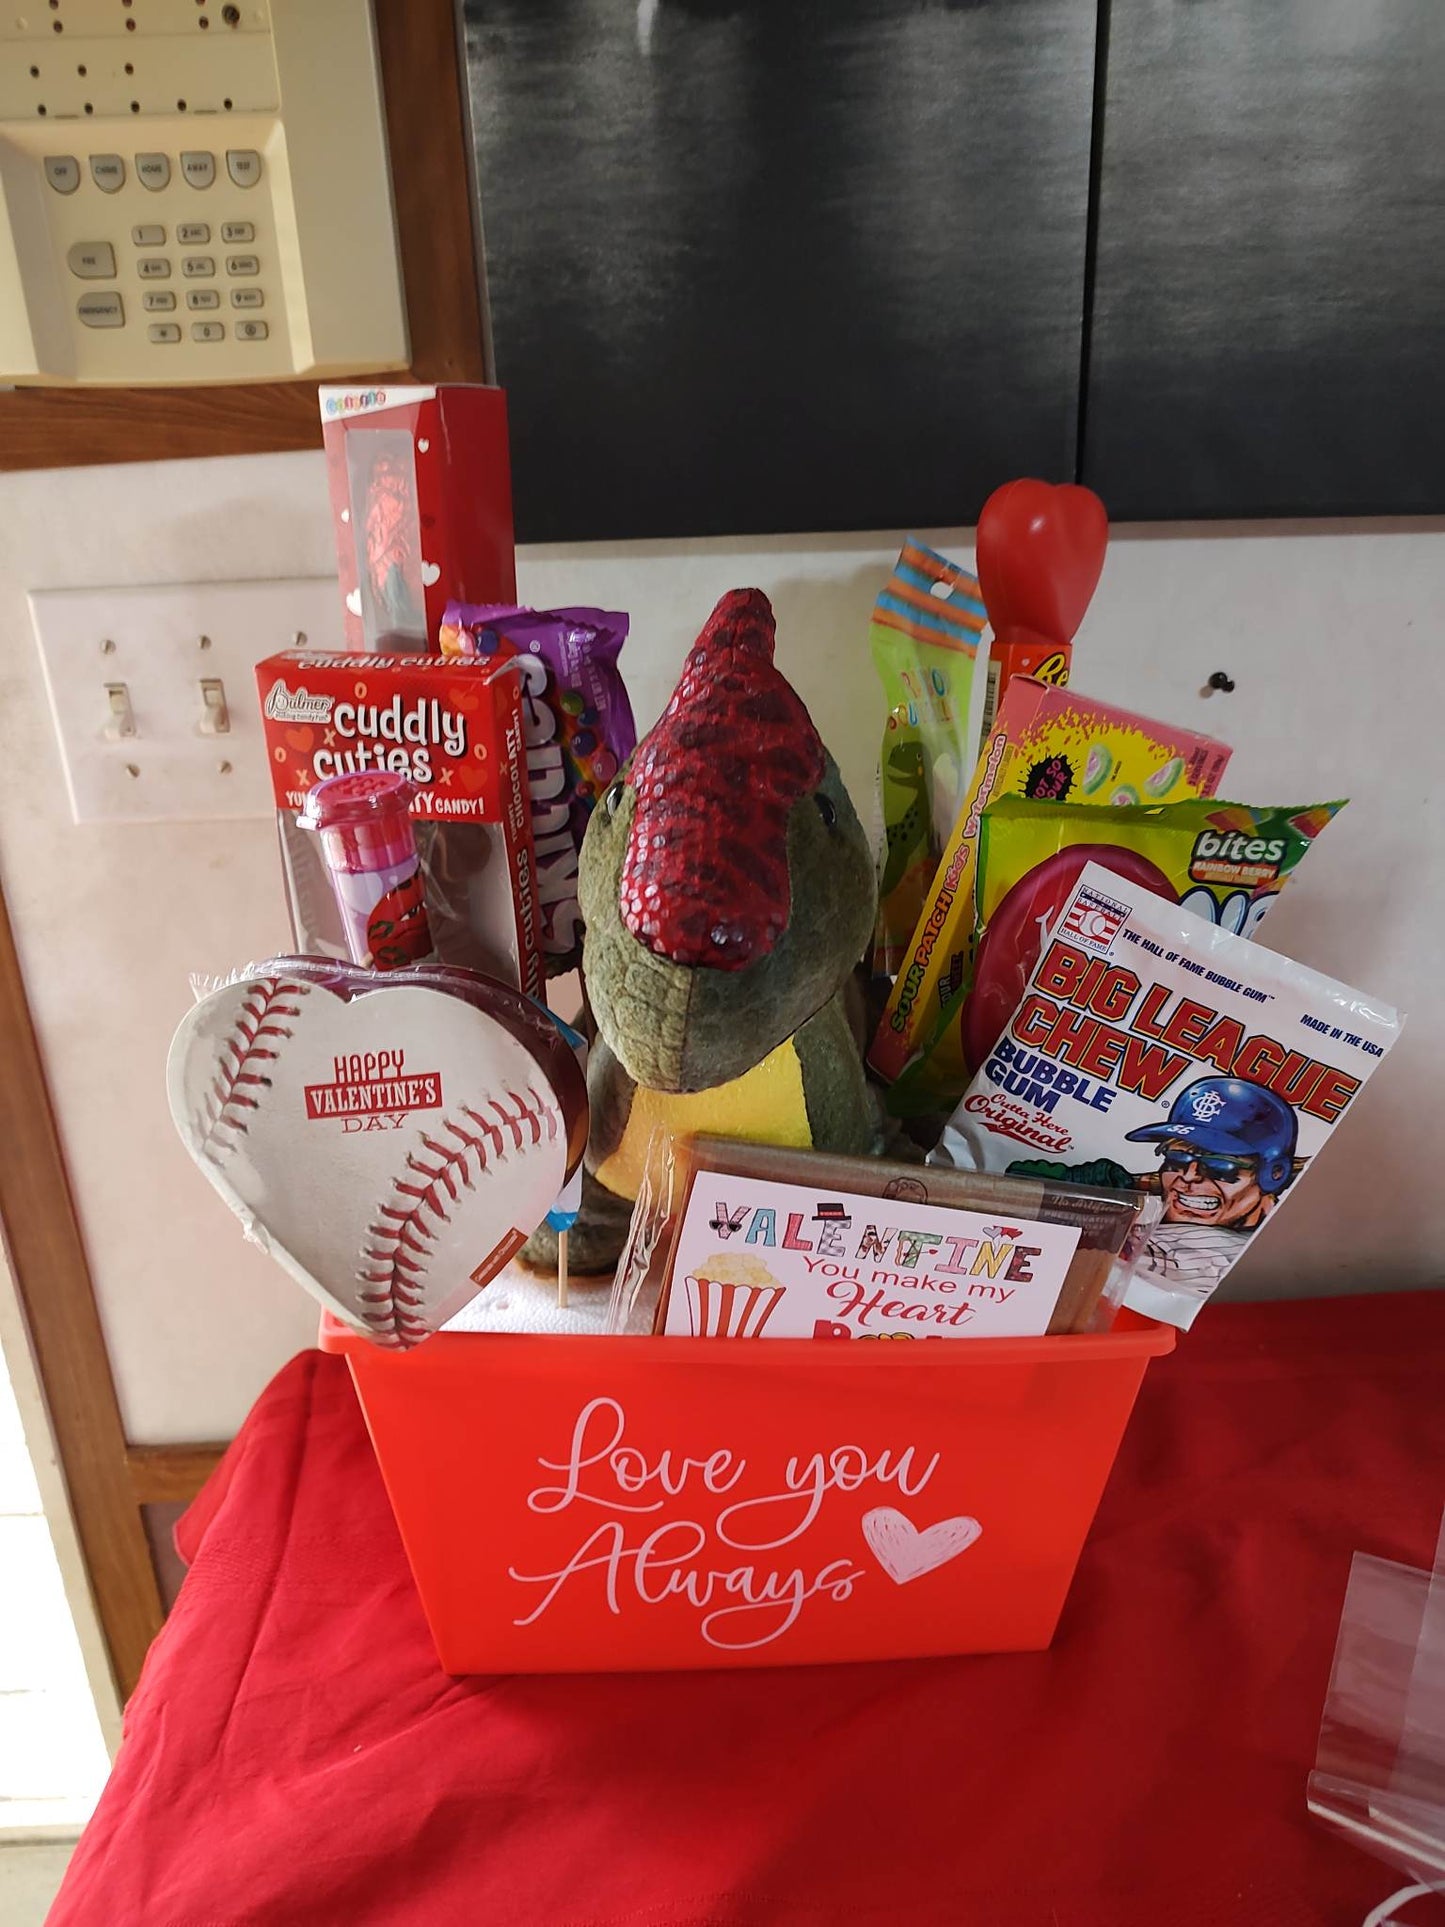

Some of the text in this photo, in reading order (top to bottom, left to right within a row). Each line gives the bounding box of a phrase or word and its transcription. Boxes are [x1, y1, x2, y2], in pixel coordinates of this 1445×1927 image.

[334, 694, 465, 757] cuddly
[435, 797, 485, 815] CANDY!
[1195, 832, 1286, 862] bites
[891, 965, 924, 1033] SOUR
[914, 889, 953, 968] PATCH
[944, 844, 971, 892] Kids
[1122, 928, 1141, 944] THE
[1141, 938, 1165, 958] HALL
[1165, 951, 1180, 963] OF
[1178, 956, 1205, 977] FAME
[1205, 969, 1243, 993] BUBBLE
[1011, 994, 1193, 1102] CHEW
[1033, 938, 1363, 1125] BIG LEAGUE
[1300, 1013, 1384, 1058] MADE IN THE USA
[333, 1049, 405, 1084] HAPPY
[984, 1058, 1062, 1114] GUM
[993, 1035, 1118, 1114] BUBBLE
[309, 1077, 437, 1115] VALENTINE'S
[341, 1113, 410, 1133] DAY
[1031, 1111, 1069, 1135] Here
[1166, 1123, 1196, 1135] 56
[708, 1201, 1043, 1283] VALENTINE
[802, 1255, 1016, 1304] You make my
[826, 1281, 978, 1327] Heart
[527, 1396, 941, 1551] Love you
[508, 1520, 867, 1650] Always
